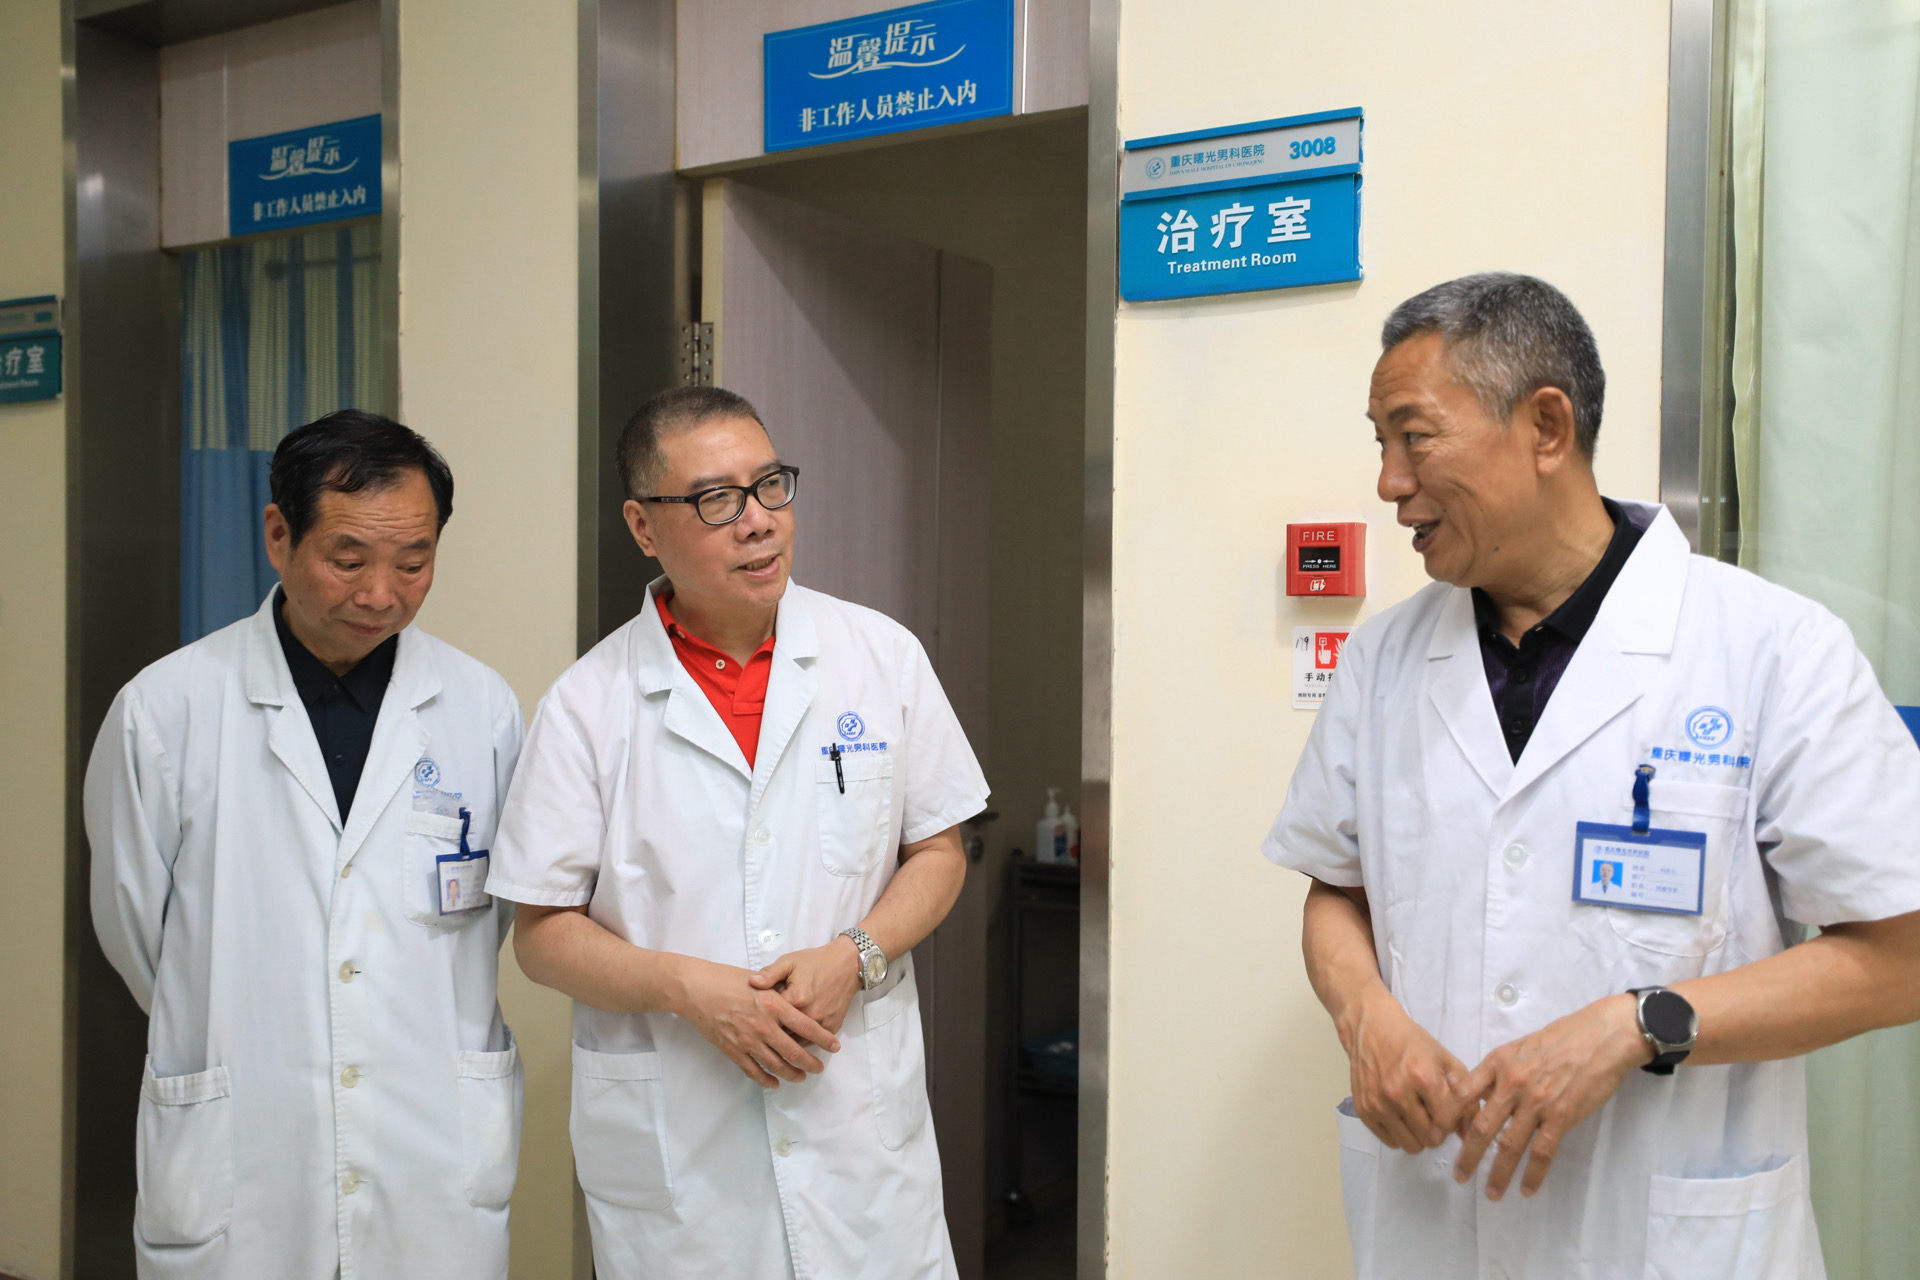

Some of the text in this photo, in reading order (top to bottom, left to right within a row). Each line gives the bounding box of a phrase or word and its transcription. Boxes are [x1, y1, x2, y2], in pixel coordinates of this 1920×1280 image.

[827, 19, 937, 70] 温馨提示
[797, 79, 978, 133] 非工作人员禁止入内
[270, 135, 341, 174] 温馨提示
[1170, 136, 1336, 168] 重庆曙光男科医院 3008
[253, 185, 366, 222] 非工作人员禁止入内
[1156, 196, 1312, 254] 治疗室
[1167, 252, 1297, 275] Treatment Room
[0, 344, 45, 376] 疗室
[1302, 530, 1336, 542] FIRE
